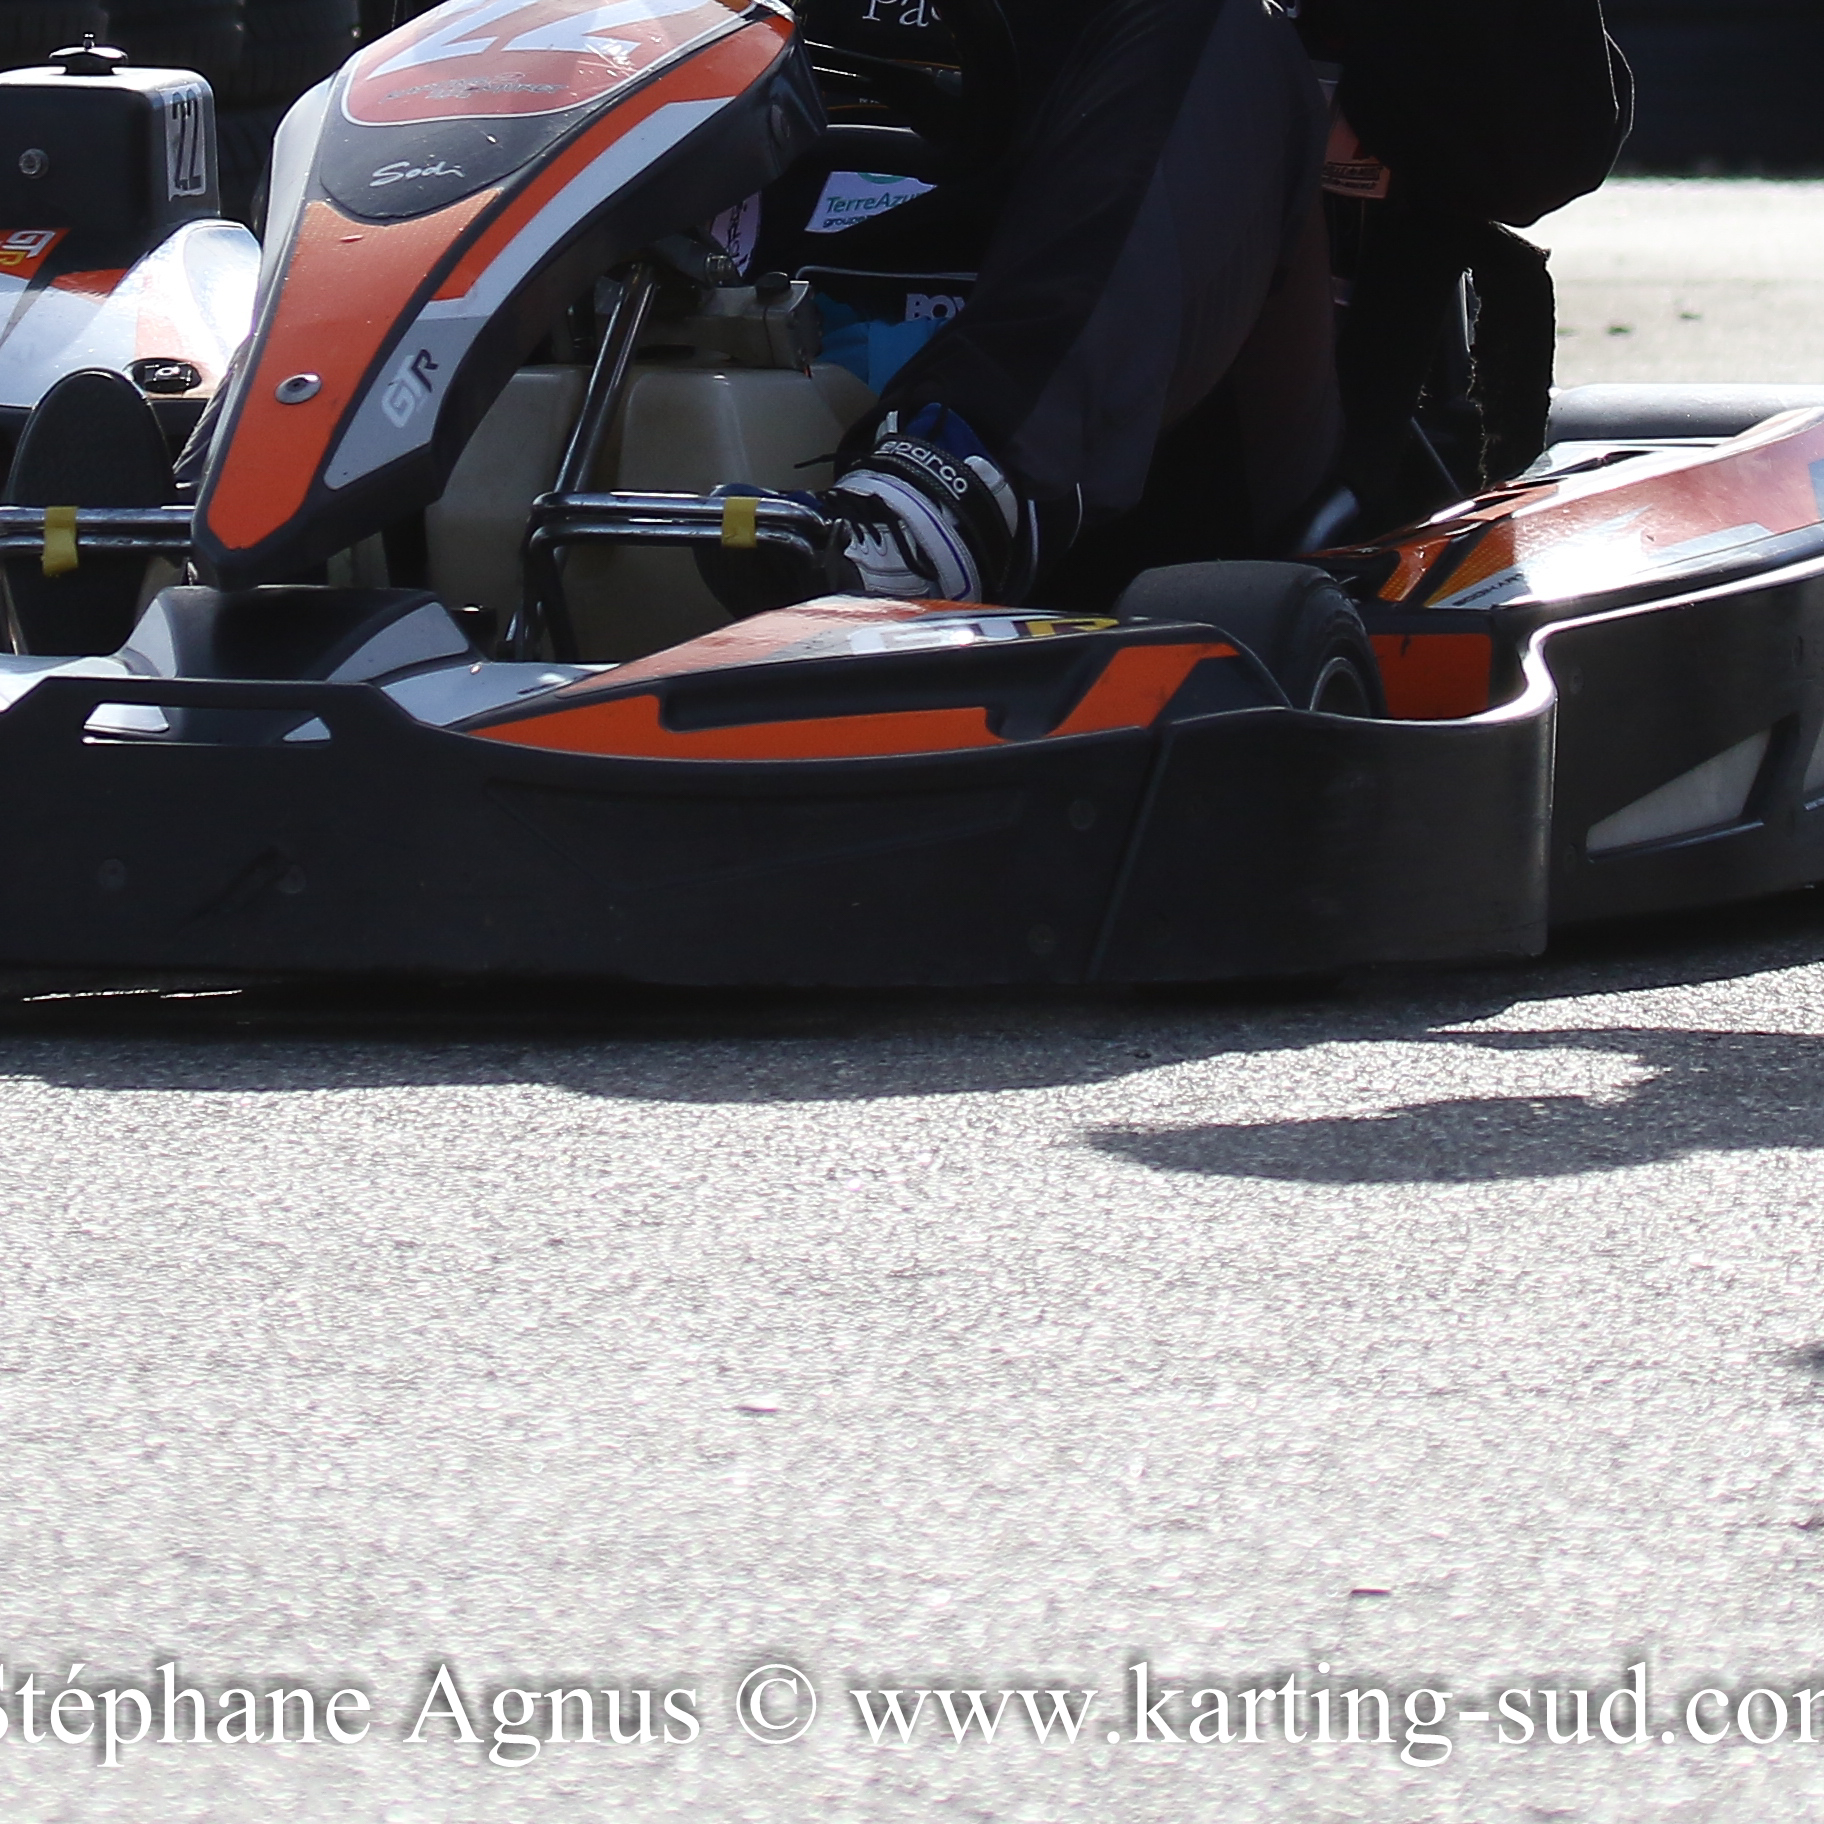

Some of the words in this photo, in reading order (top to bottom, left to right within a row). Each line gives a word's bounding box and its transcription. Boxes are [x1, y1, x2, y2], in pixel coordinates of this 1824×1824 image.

[171, 88, 203, 191] 22
[369, 161, 466, 187] Sodi
[381, 348, 439, 429] GTR
